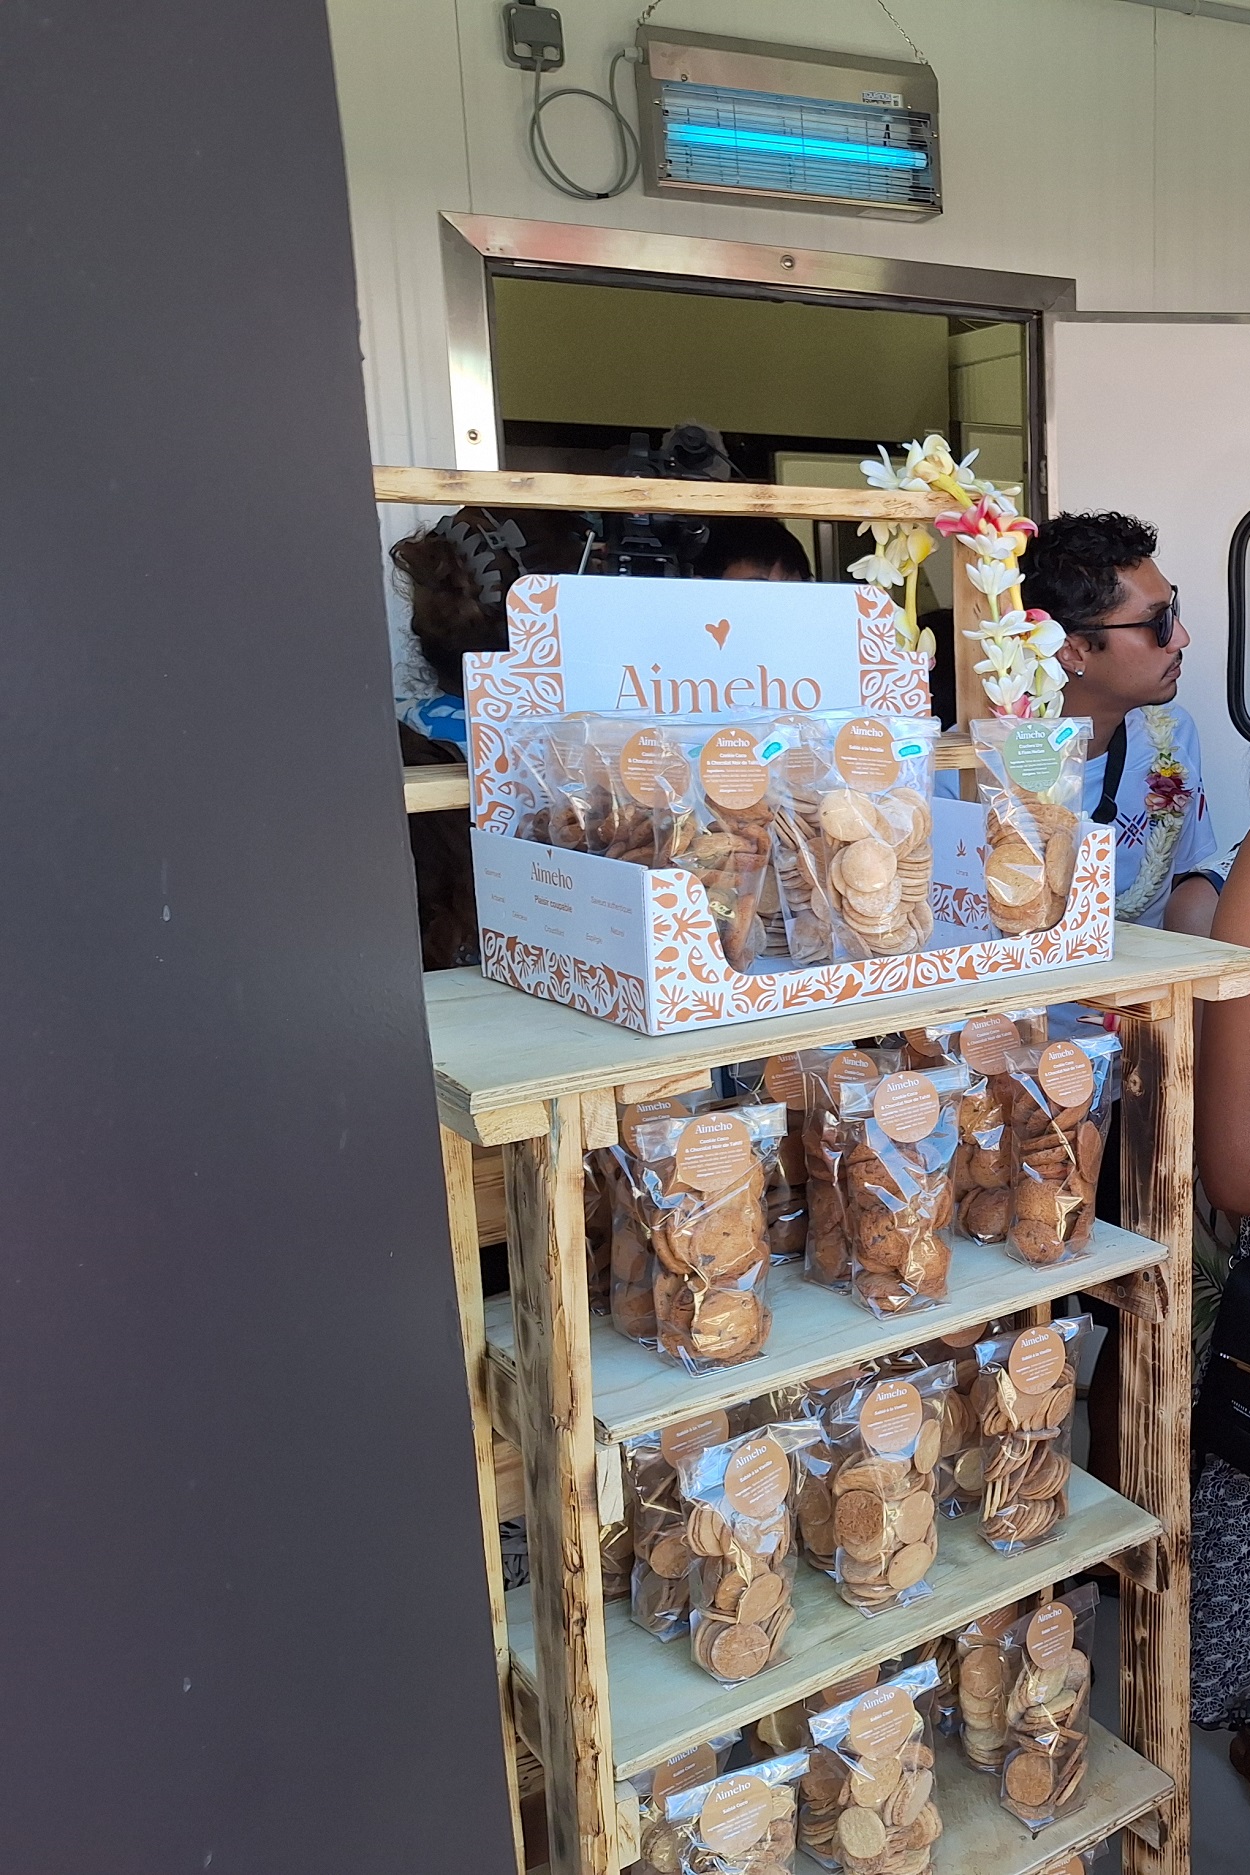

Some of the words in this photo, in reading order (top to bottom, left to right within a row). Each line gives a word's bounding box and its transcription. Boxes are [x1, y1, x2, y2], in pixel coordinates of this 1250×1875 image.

[615, 663, 822, 714] Aimeho
[850, 725, 884, 738] Aimeho
[1016, 730, 1046, 740] Aimeho
[716, 737, 750, 748] Aimeho
[531, 861, 574, 890] Aimeho
[971, 1017, 1001, 1030] Aimeho
[1048, 1049, 1075, 1060] Aimeho
[842, 1056, 869, 1068] Aimeho
[886, 1078, 920, 1092] Aimeho
[636, 1101, 672, 1113] Aimeho
[694, 1121, 733, 1135] Aimeho
[690, 1145, 712, 1153] Chocolat
[1021, 1333, 1049, 1348] Aimeho
[876, 1388, 908, 1401] Aimeho
[735, 1445, 767, 1468] Aimeho
[1038, 1609, 1062, 1623] Aimeho
[863, 1691, 895, 1711] Aimeho
[667, 1745, 699, 1767] Aimeho
[715, 1781, 751, 1802] Aimeho
